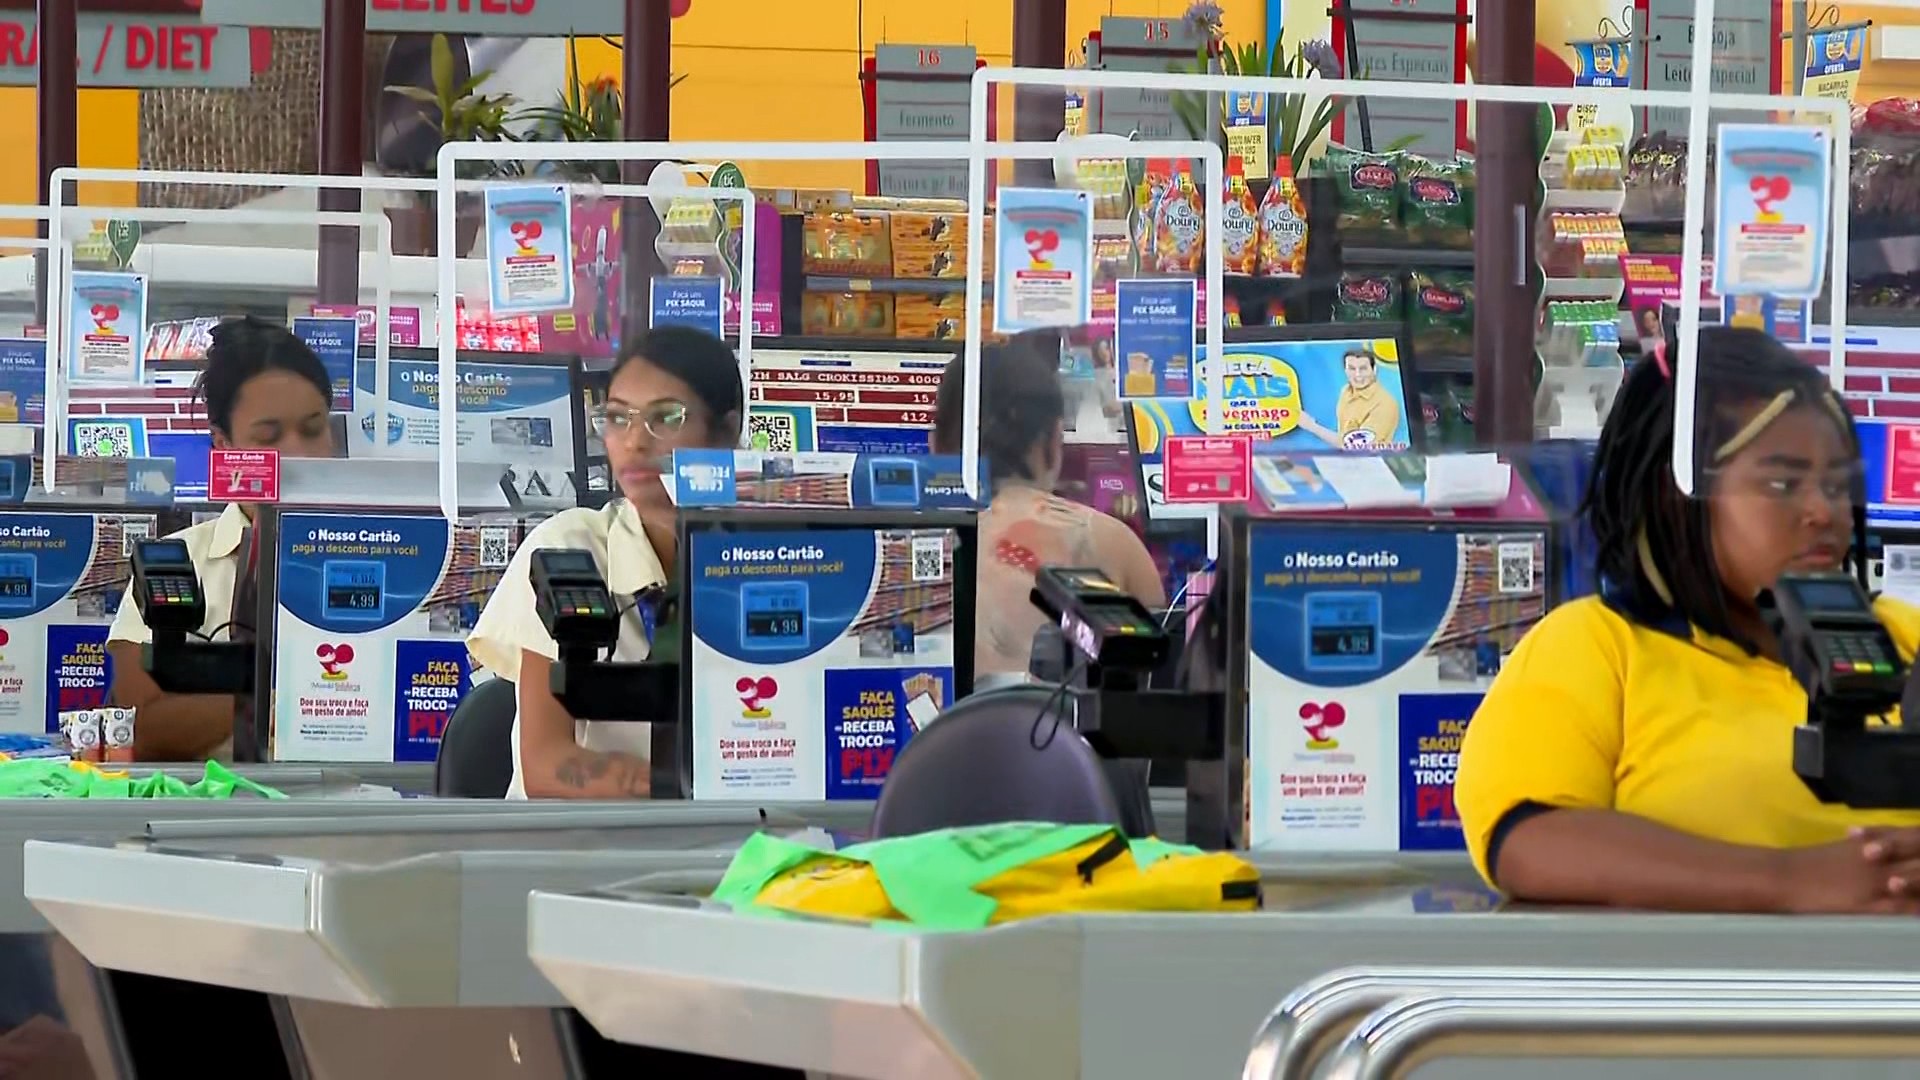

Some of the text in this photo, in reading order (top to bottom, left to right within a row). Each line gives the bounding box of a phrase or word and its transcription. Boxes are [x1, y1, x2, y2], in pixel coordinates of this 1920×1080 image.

[1144, 21, 1169, 41] 15
[93, 24, 113, 74] /
[125, 25, 218, 70] DIET
[917, 48, 941, 67] 16
[900, 110, 955, 128] Fermento
[1166, 215, 1200, 231] Downy
[1267, 218, 1303, 235] Downy
[665, 299, 706, 308] PIX SAQUE
[1132, 305, 1177, 315] PIX SAQUE
[319, 338, 342, 347] SAQUE
[777, 372, 810, 382] SALG
[817, 373, 900, 384] CROKISSIMO
[908, 375, 941, 385] 400G
[815, 391, 854, 403] 15,95
[1230, 400, 1248, 408] QUE
[12, 524, 51, 538] Cartão
[318, 529, 357, 542] Nosso
[359, 529, 401, 543] Cartão
[292, 544, 419, 556] paga o desconto para você!
[733, 547, 775, 561] Nosso
[777, 545, 824, 561] Cartão
[1296, 552, 1344, 568] Nosso
[1346, 551, 1399, 568] Cartão
[705, 562, 844, 578] paga o desconto para você!
[350, 594, 375, 608] 4.99
[76, 642, 105, 656] FAÇA
[61, 653, 105, 665] SAQUES
[61, 665, 104, 677] RECEBA
[428, 660, 460, 675] FAÇA
[58, 677, 94, 688] TROCO
[411, 672, 459, 686] SAQUES
[411, 686, 458, 698] RECEBA
[860, 690, 894, 706] FAÇA
[300, 698, 369, 709] Doe seu troco e faça
[407, 699, 448, 711] TROCO
[301, 709, 312, 717] um
[314, 708, 334, 718] gesto
[335, 707, 344, 717] de
[842, 705, 895, 720] SAQUES
[843, 719, 895, 733] RECEBA
[1438, 719, 1468, 737] FAÇ
[720, 737, 796, 749] Doe seu troco e faça
[838, 735, 884, 748] TROCO
[722, 751, 734, 760] um
[736, 750, 758, 762] gesto
[759, 749, 769, 760] de
